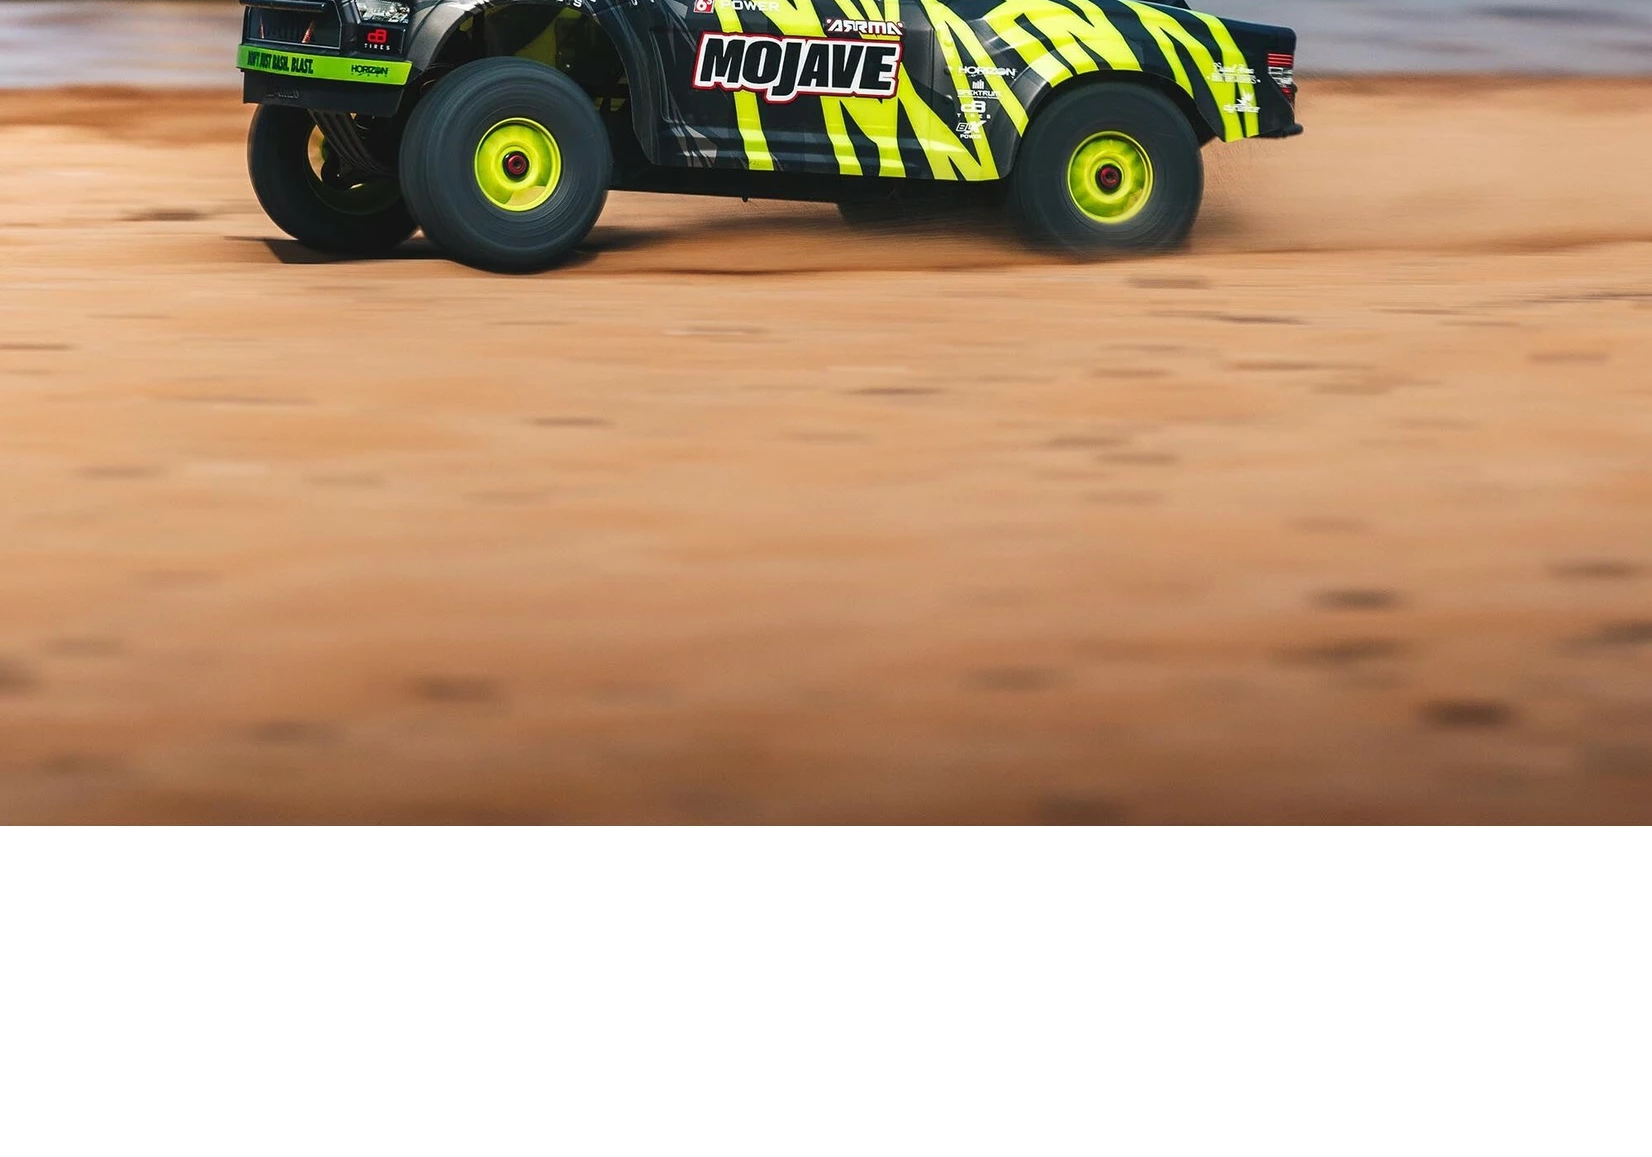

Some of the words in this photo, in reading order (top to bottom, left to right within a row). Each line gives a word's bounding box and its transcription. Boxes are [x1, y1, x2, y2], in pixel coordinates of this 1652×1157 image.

[364, 43, 391, 51] TIRES
[291, 57, 314, 75] BLAST.
[351, 64, 389, 75] HORIZON
[696, 35, 900, 100] MOJAVE
[958, 66, 1017, 76] HORIZON
